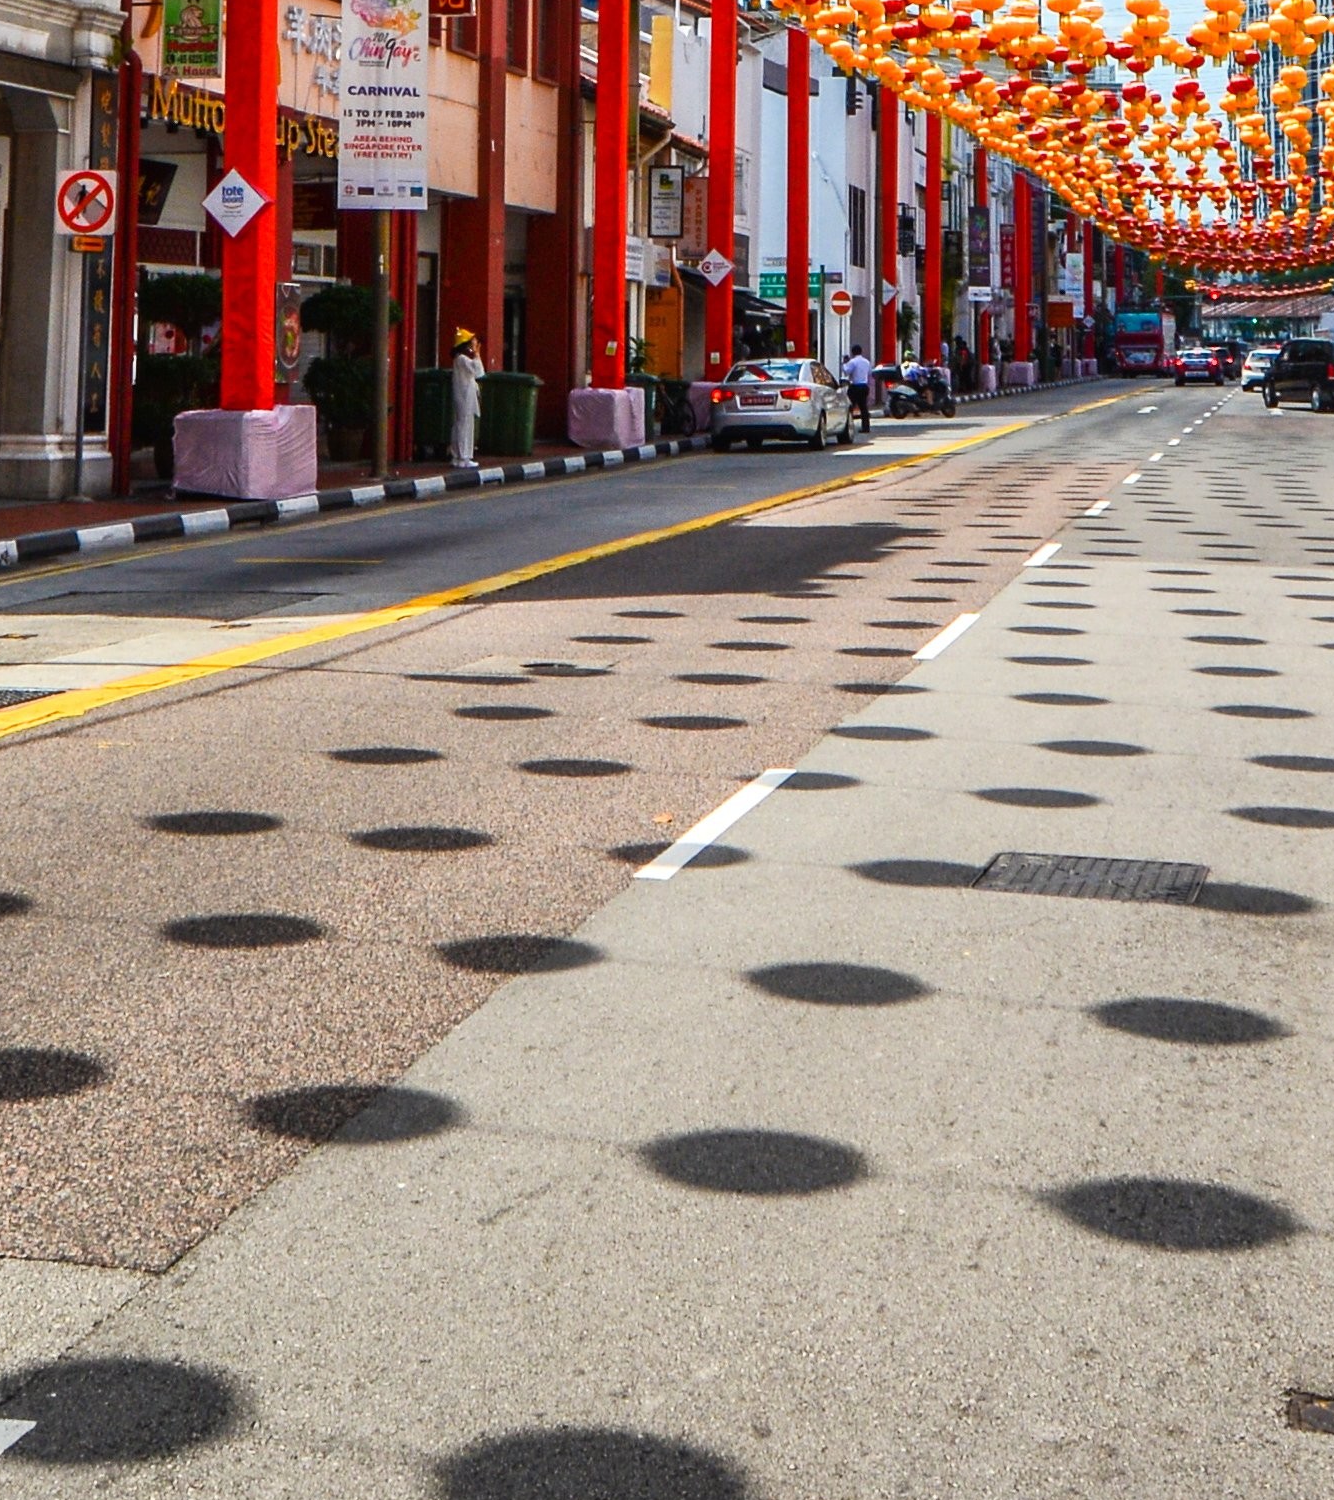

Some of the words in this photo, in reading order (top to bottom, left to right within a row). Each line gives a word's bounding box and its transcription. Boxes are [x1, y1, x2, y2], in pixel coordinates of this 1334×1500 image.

[347, 85, 420, 98] CARNIVAL
[153, 76, 226, 134] Mutto
[343, 109, 353, 117] 15
[356, 109, 370, 118] TO
[373, 110, 383, 118] 17
[385, 110, 403, 119] FEB
[405, 111, 425, 119] 2019
[387, 120, 412, 128] 10PM
[344, 143, 394, 151] SINGAPORE
[222, 186, 244, 196] tote
